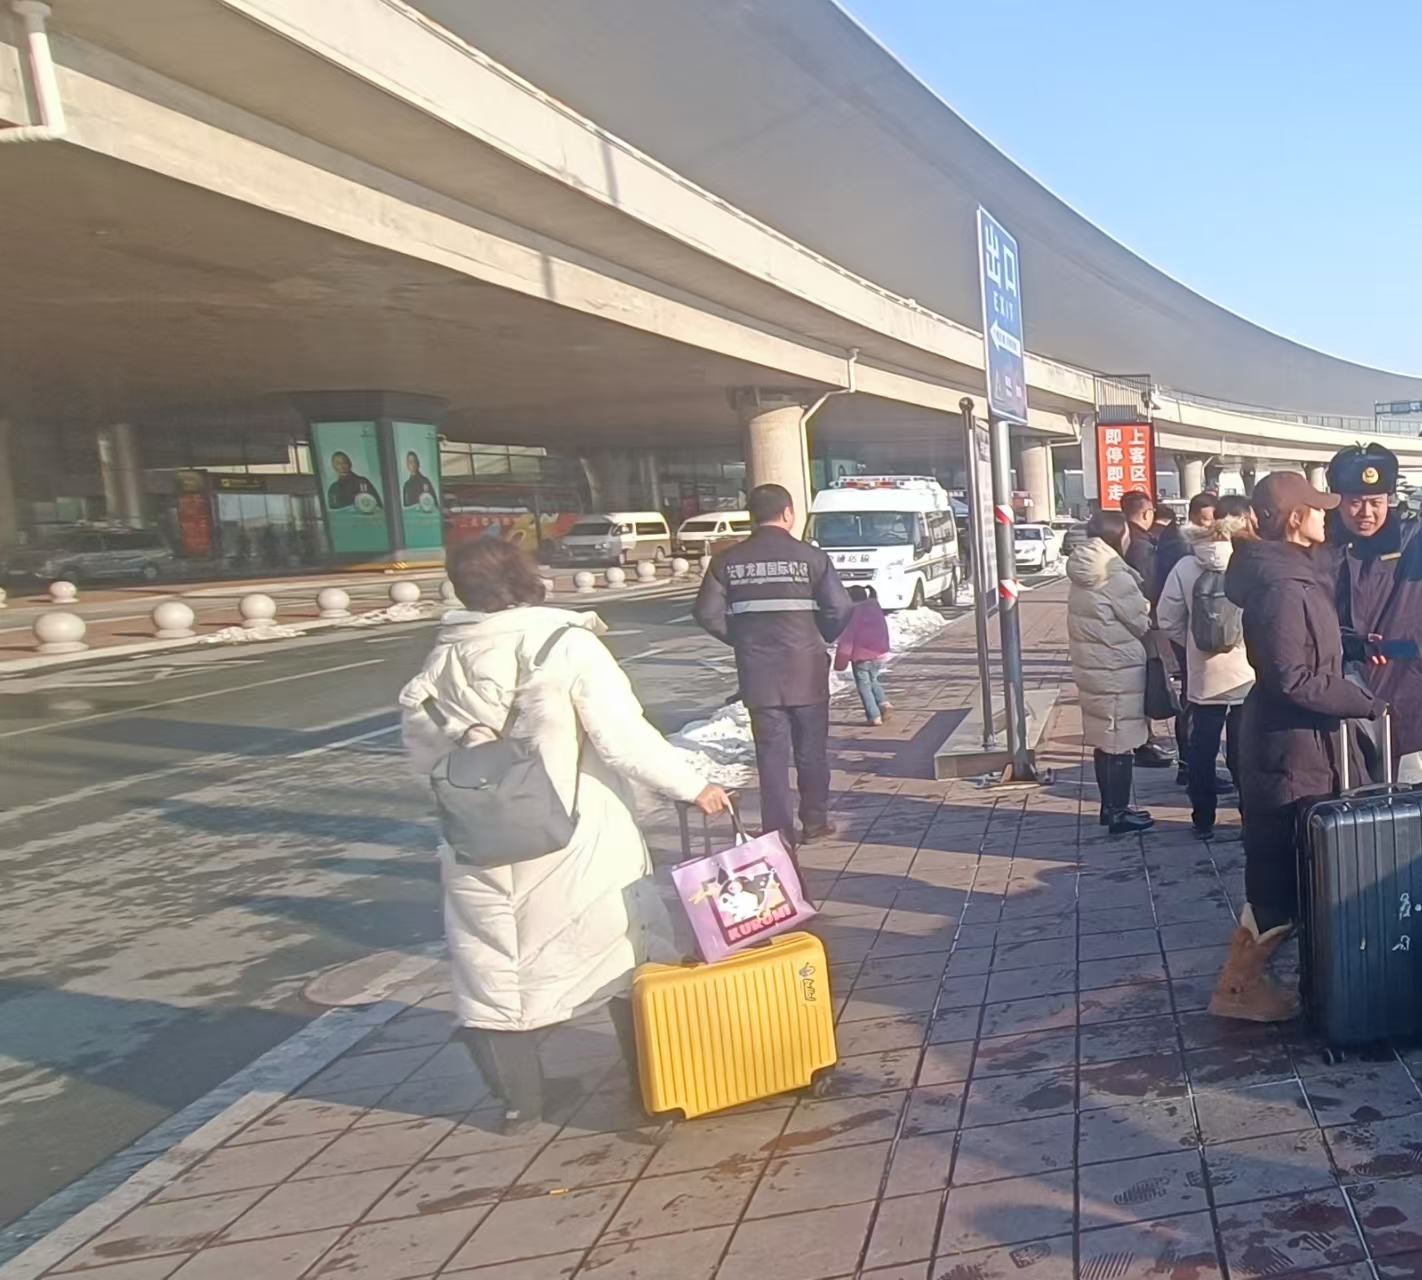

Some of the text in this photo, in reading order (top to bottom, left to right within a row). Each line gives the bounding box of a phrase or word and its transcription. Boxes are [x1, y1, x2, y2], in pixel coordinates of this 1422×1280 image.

[984, 224, 1016, 297] 出口
[993, 290, 1014, 321] EXIT
[1105, 428, 1124, 501] 即停即走
